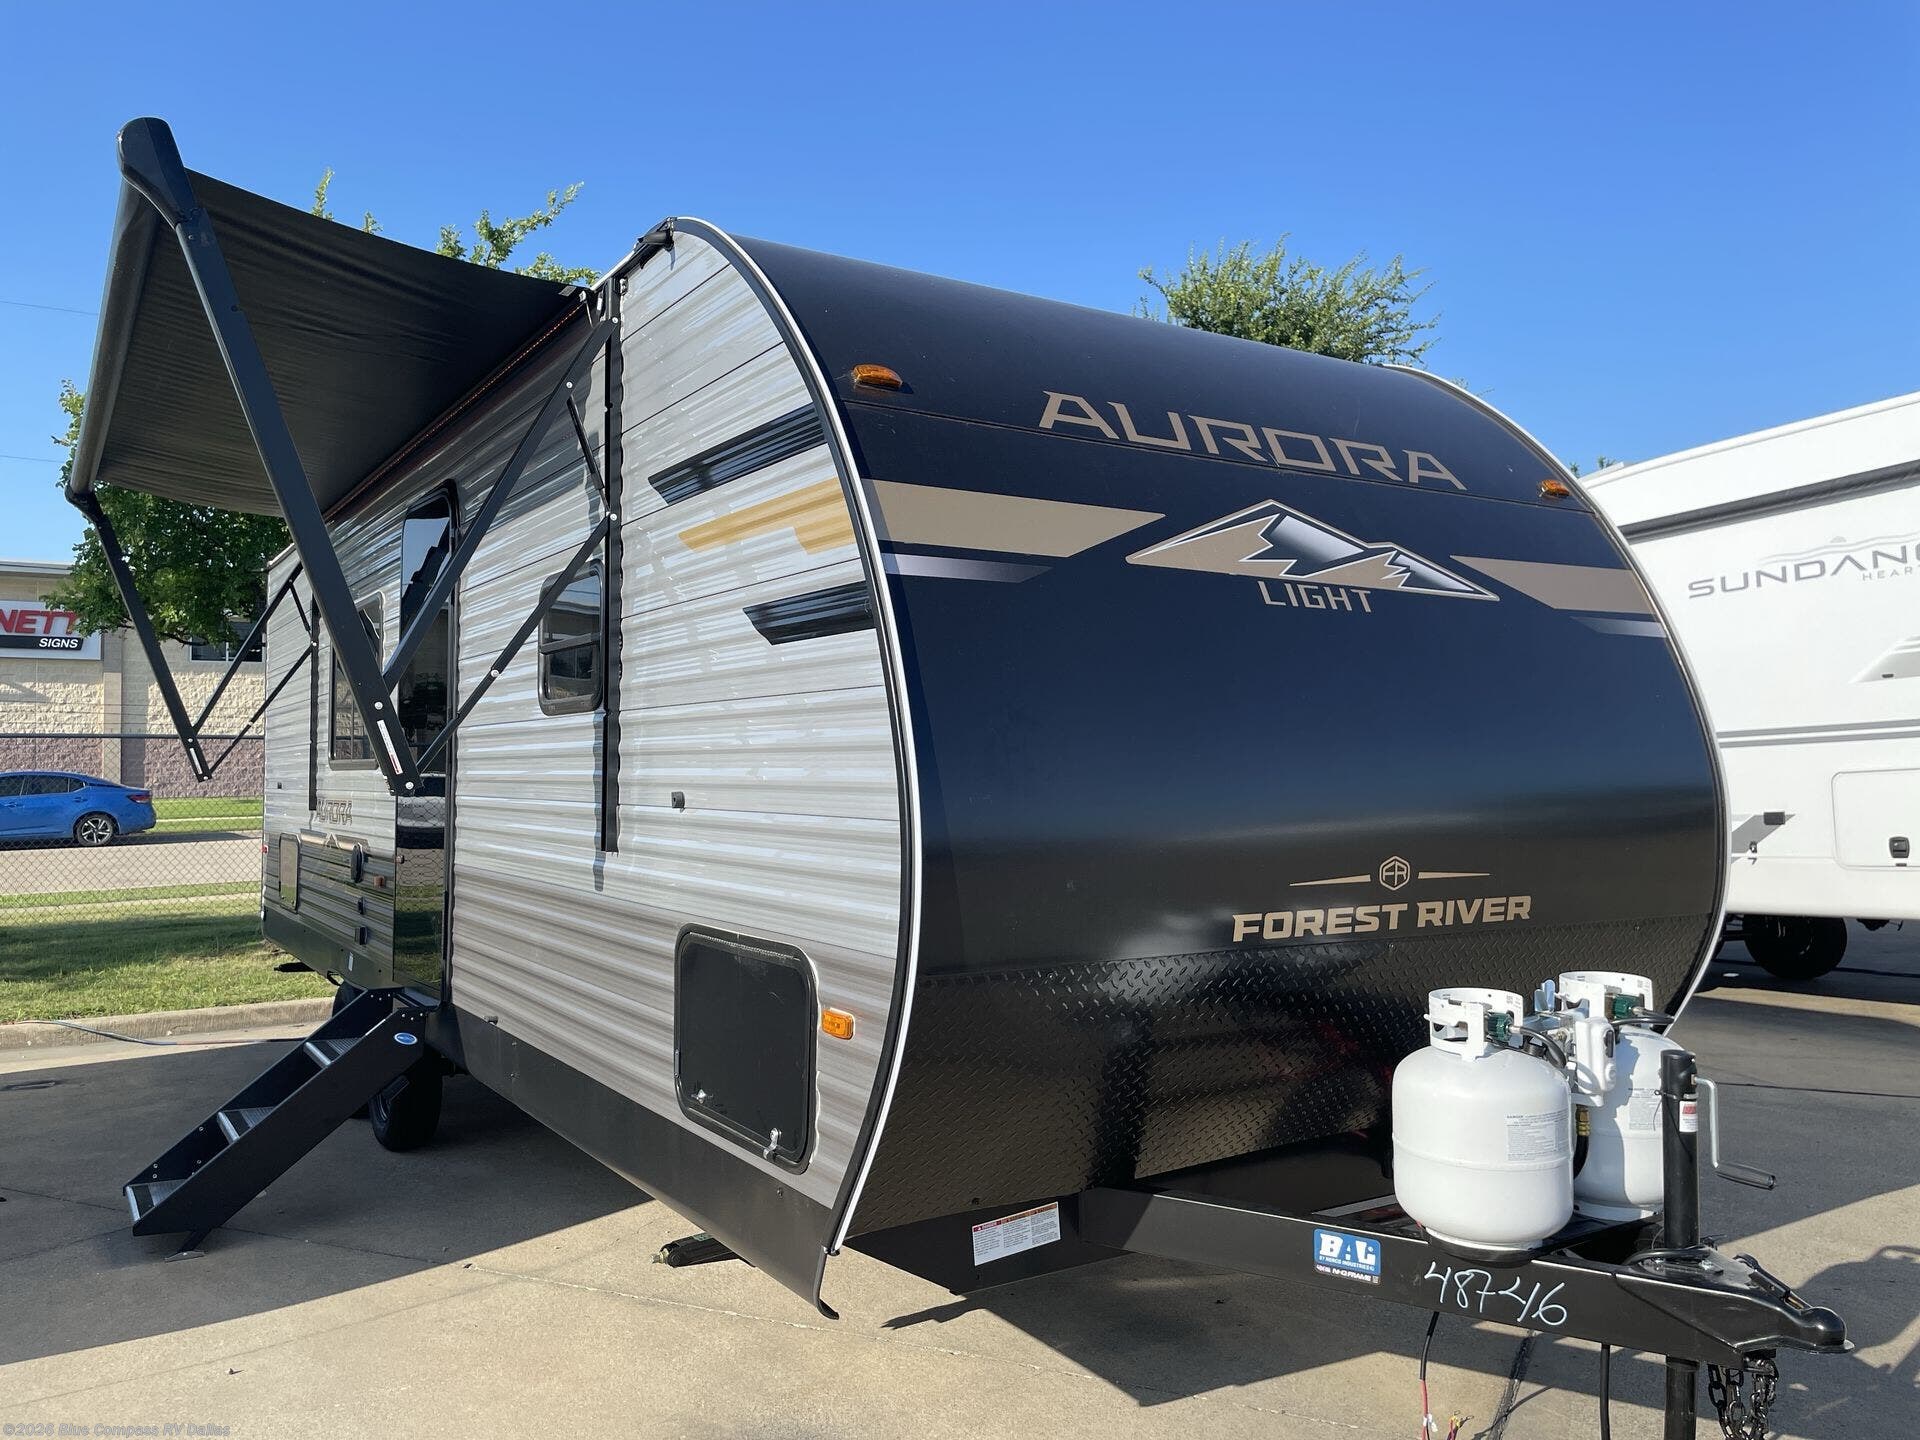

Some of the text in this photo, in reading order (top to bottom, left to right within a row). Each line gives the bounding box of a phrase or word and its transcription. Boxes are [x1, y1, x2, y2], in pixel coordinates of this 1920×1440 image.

[1038, 390, 1468, 491] AURORA
[1862, 563, 1920, 581] HEAR
[1258, 581, 1372, 614] LIGHT
[38, 638, 79, 649] SIGNS
[1232, 895, 1532, 942] FOREST RIVER
